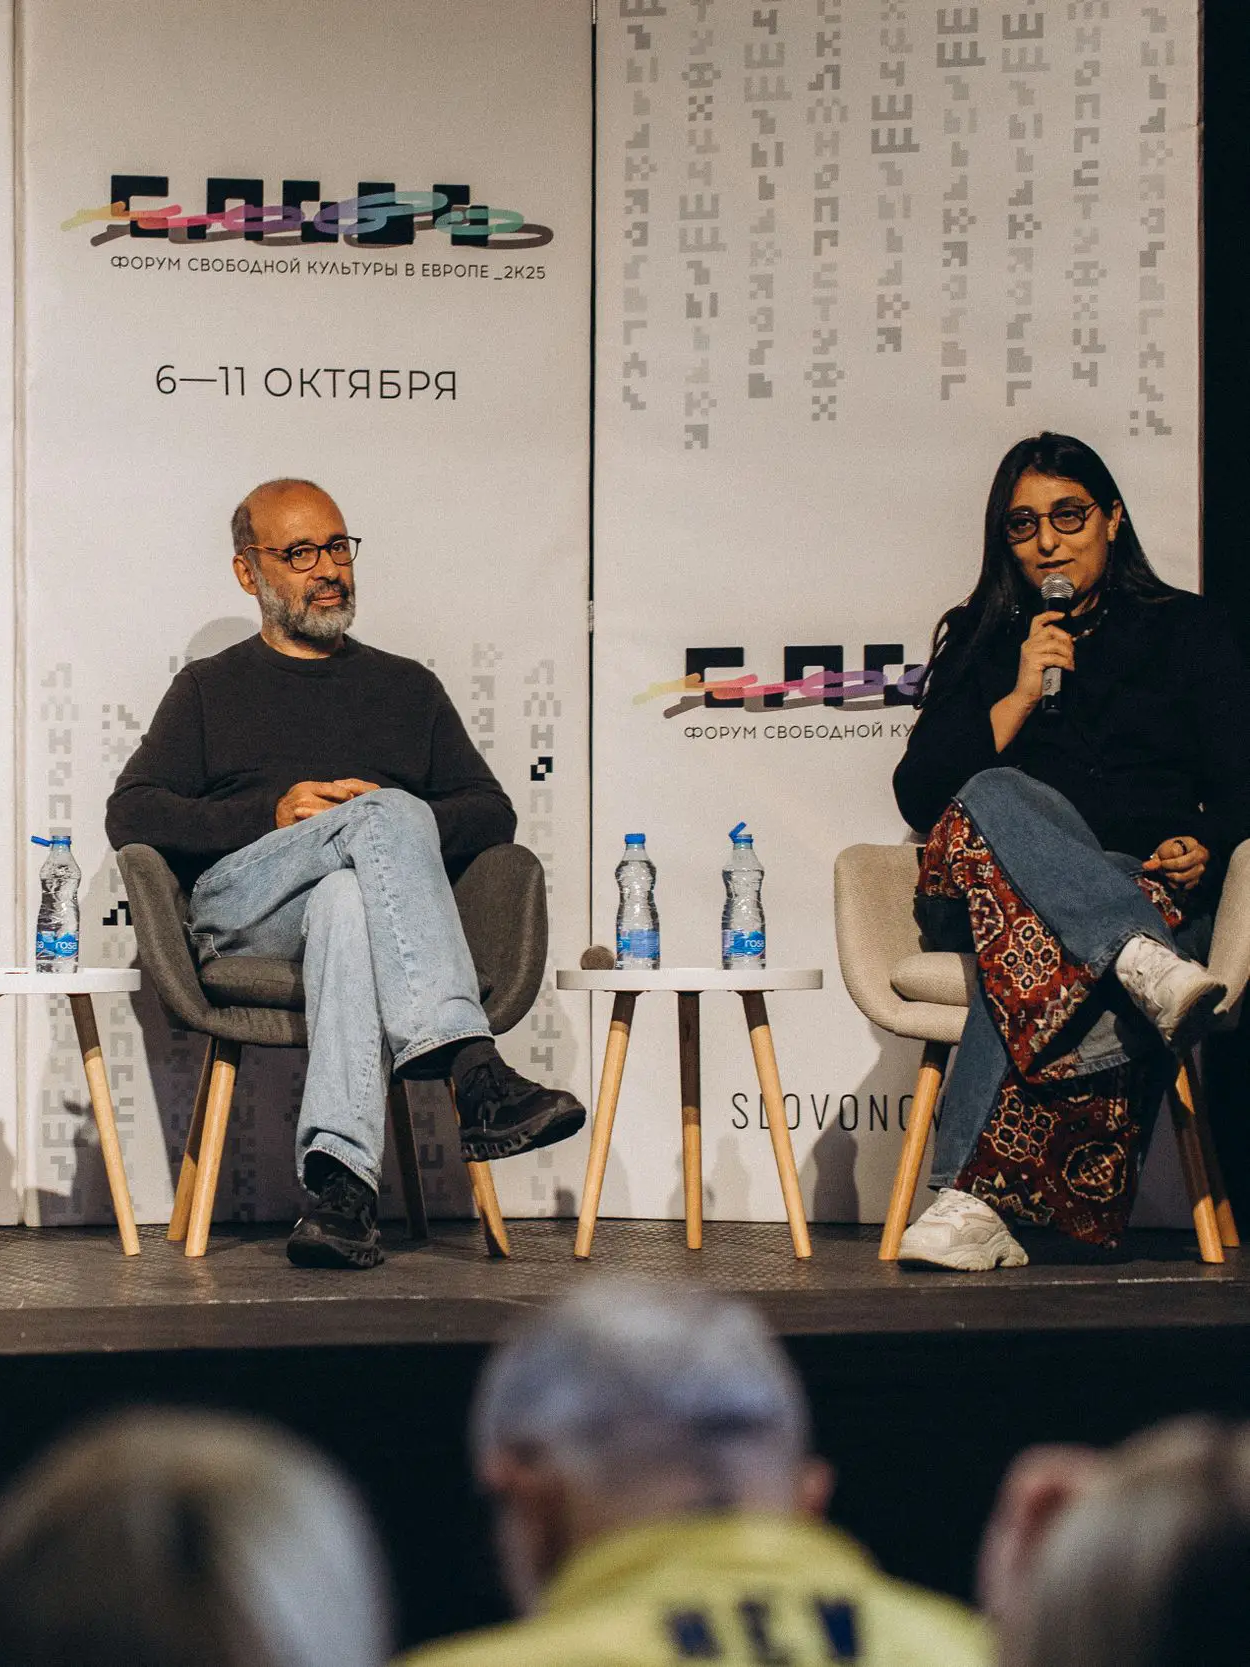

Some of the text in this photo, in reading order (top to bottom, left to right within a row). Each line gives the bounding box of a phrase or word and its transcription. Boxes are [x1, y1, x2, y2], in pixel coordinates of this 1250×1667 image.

[110, 255, 181, 271] ФОРУМ
[187, 256, 301, 276] СВОБОДНОЙ
[307, 260, 398, 277] КУЛЬТУРЫ
[404, 262, 416, 277] В
[421, 262, 489, 279] ЕВРОПЕ
[263, 367, 457, 401] ОКТЯБРЯ
[683, 726, 757, 740] ФОРУМ
[763, 722, 883, 741] СВОБОДНОЙ
